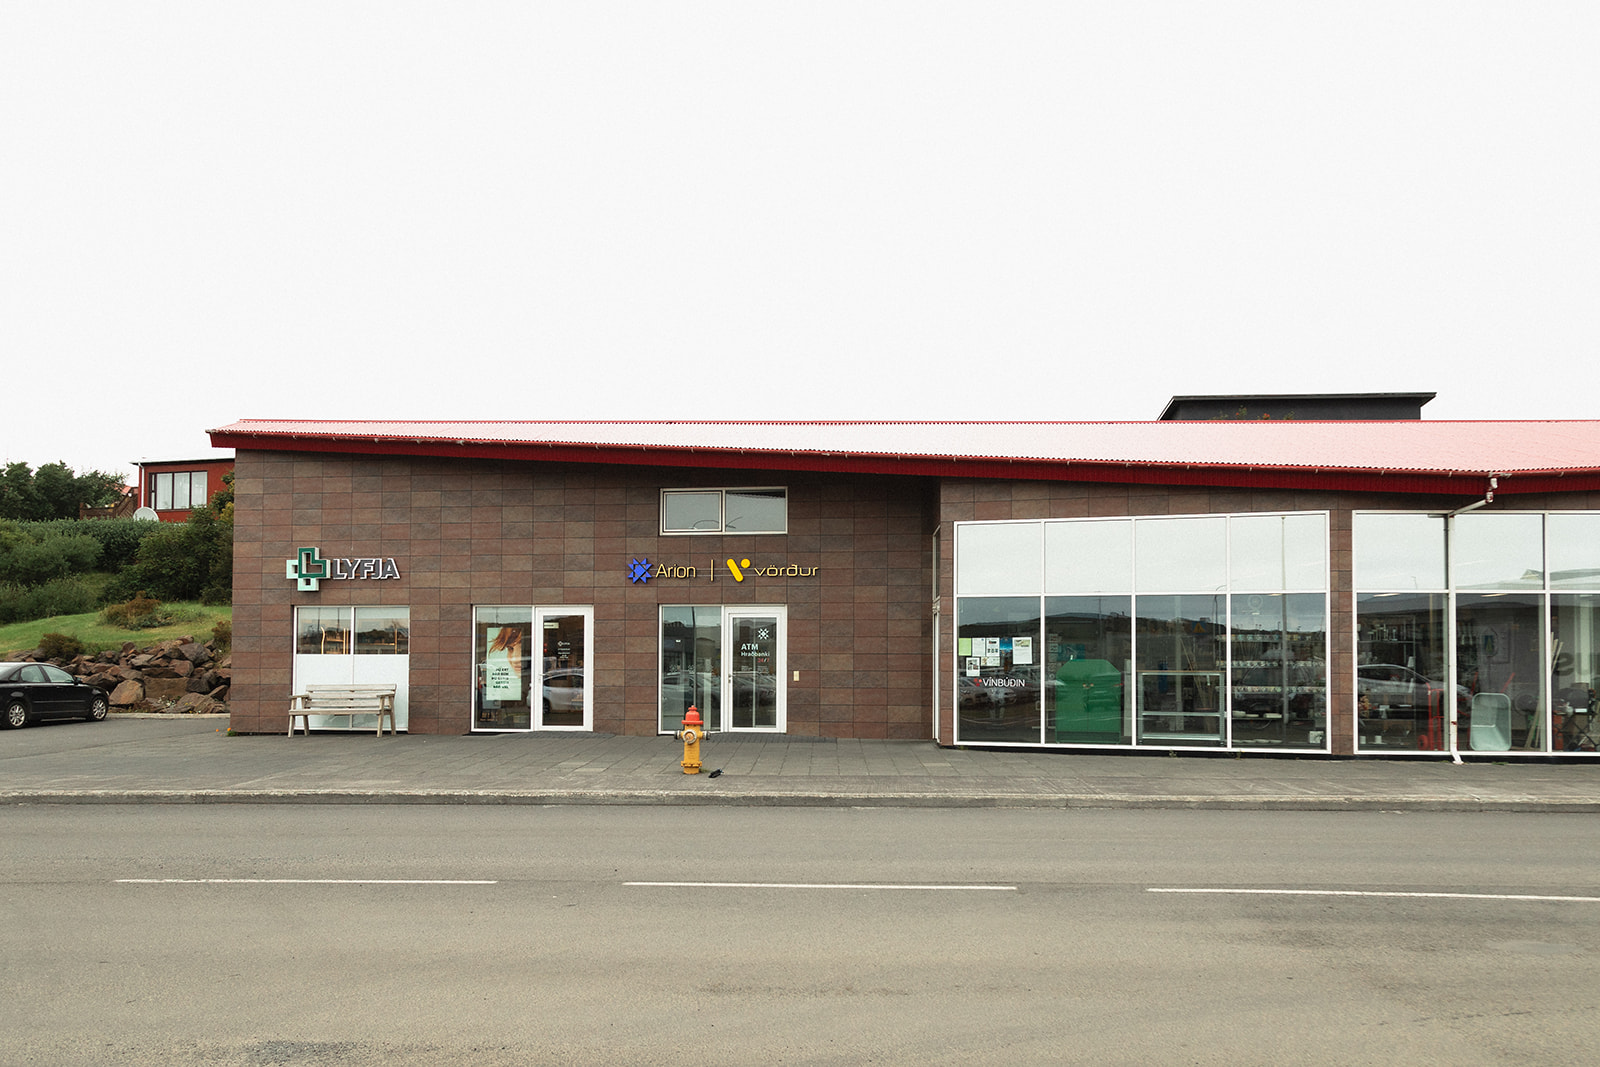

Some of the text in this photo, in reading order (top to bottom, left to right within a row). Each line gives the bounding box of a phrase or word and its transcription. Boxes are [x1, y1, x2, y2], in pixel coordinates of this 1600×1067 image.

[332, 558, 400, 579] LYFJA
[655, 563, 696, 578] Arion
[754, 564, 819, 577] vörður
[983, 676, 1026, 687] VÍNBÚÐIN
